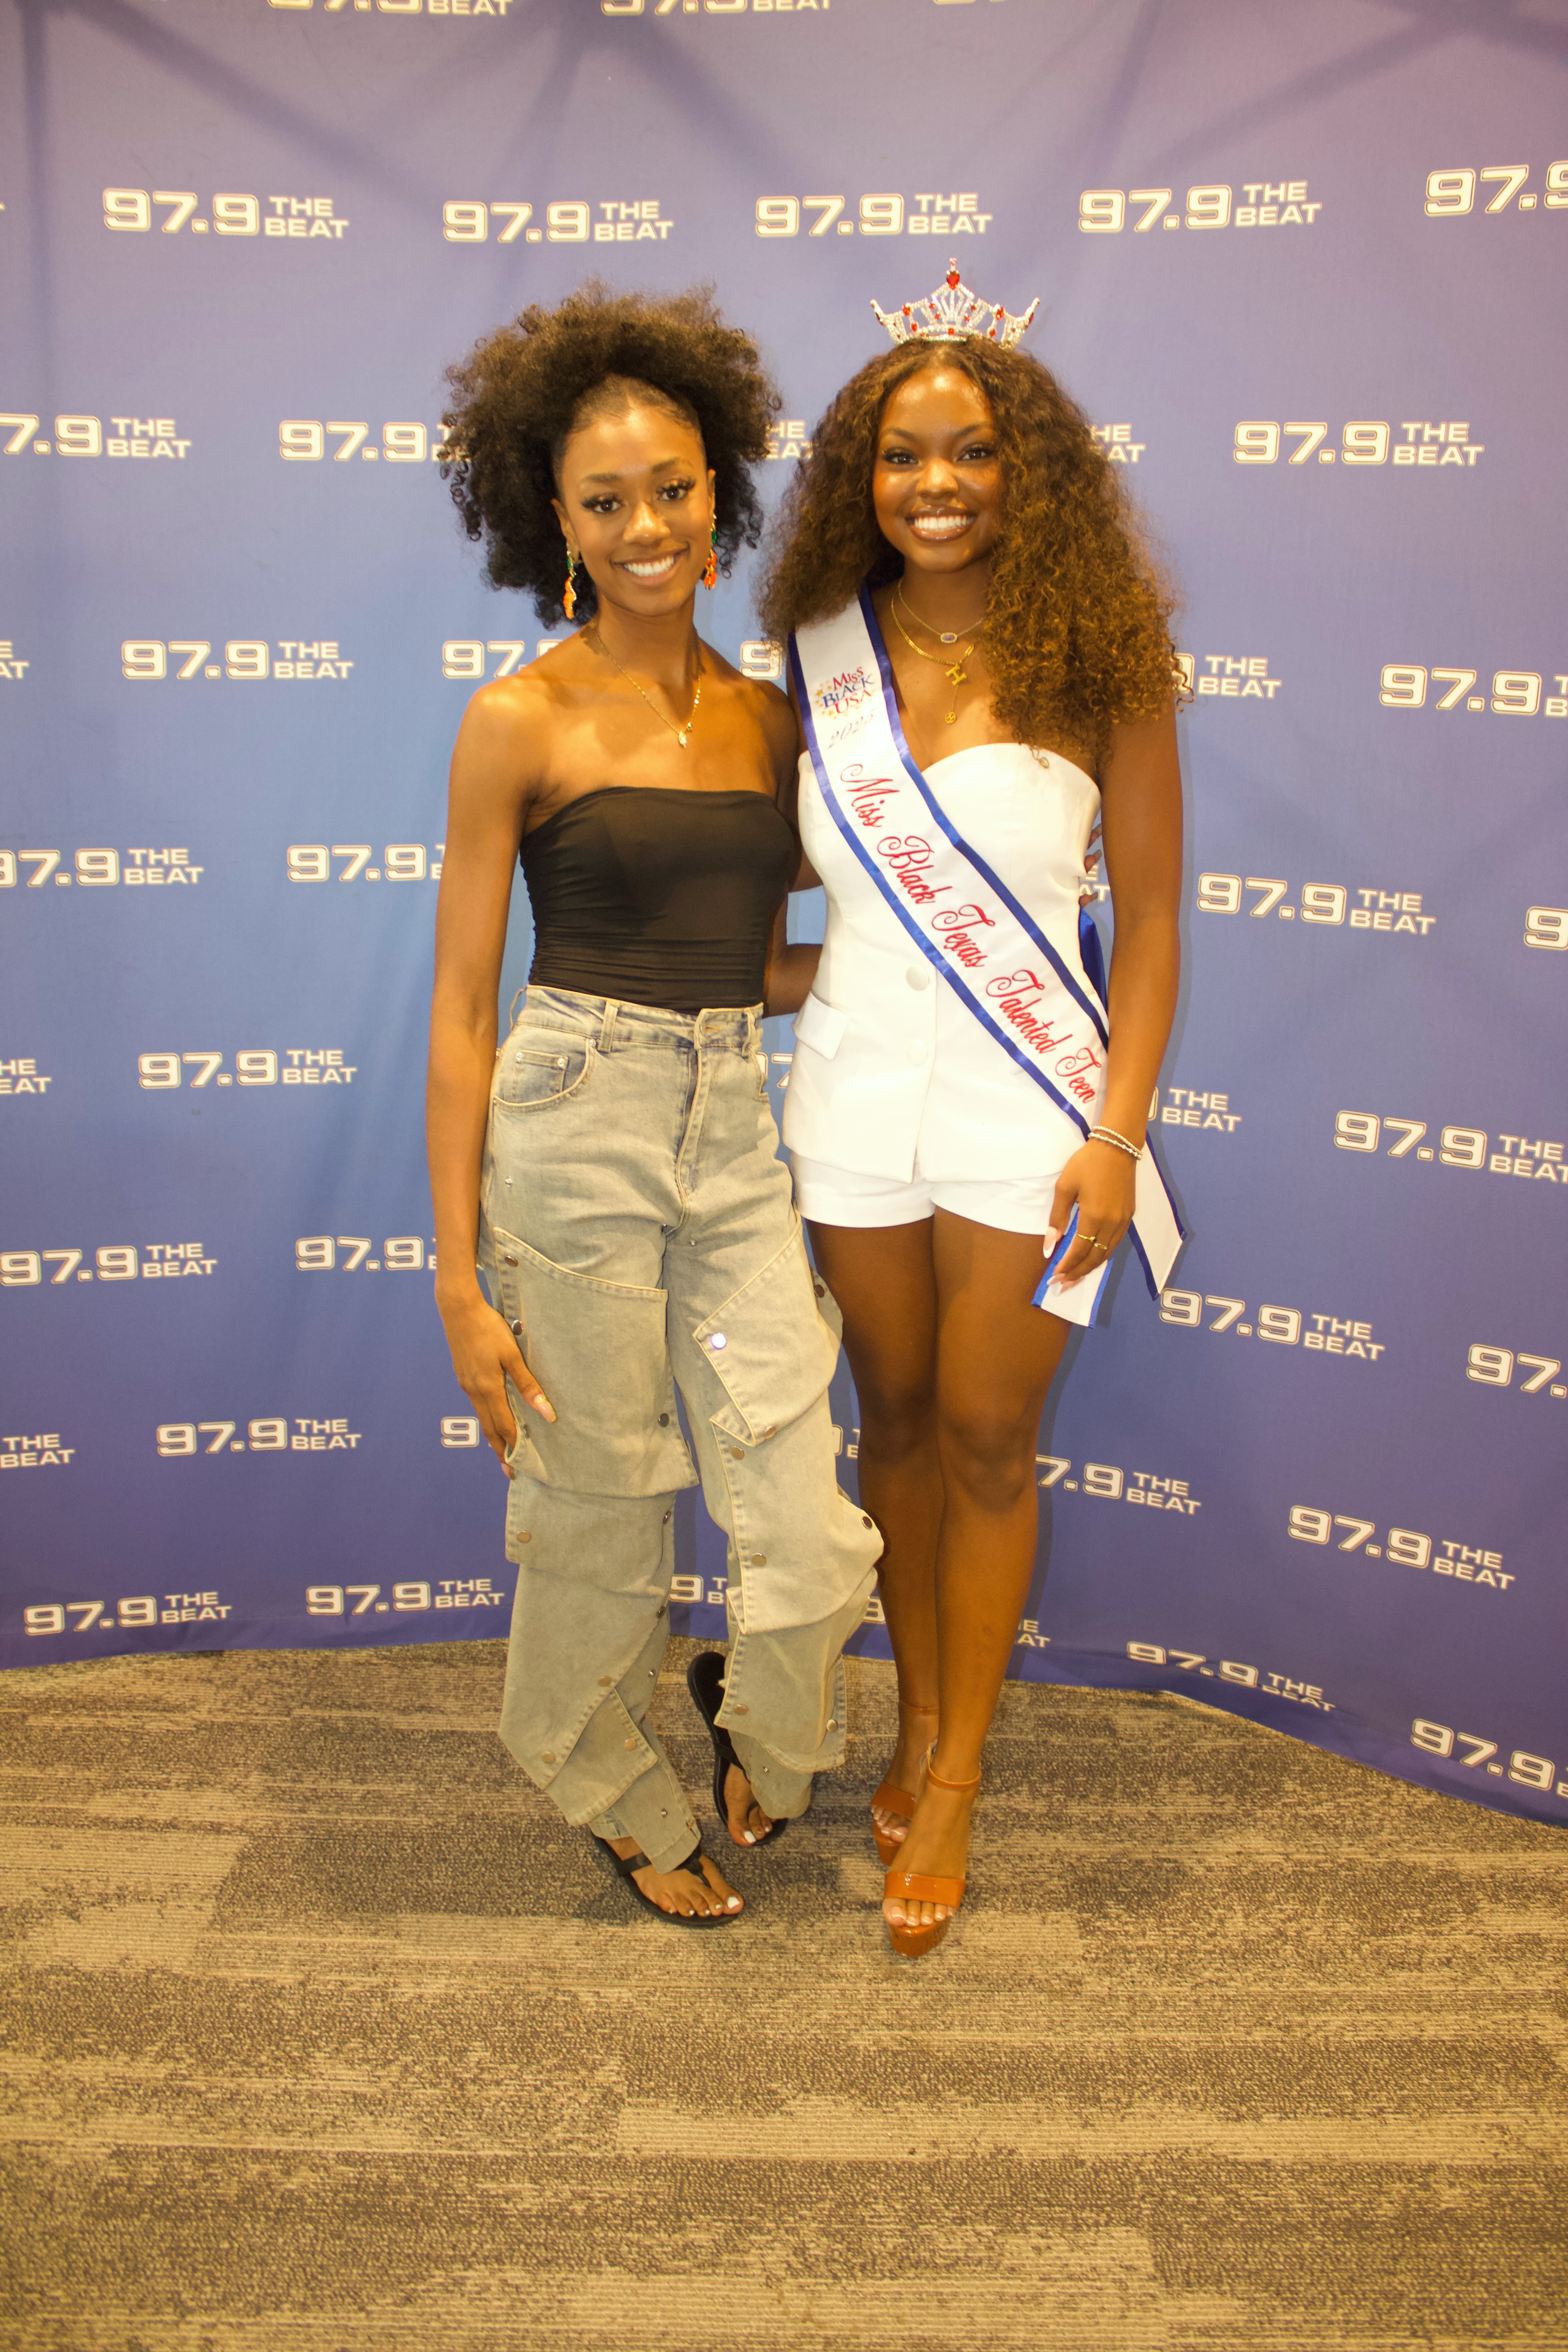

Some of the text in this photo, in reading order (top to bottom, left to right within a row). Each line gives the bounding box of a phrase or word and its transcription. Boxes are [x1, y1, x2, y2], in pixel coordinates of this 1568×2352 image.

[427, 0, 512, 15] BEAT
[915, 193, 978, 212] THE
[1243, 181, 1307, 203] THE
[103, 187, 260, 235] 97.9
[269, 196, 333, 216] THE
[600, 201, 659, 220] THE
[755, 194, 904, 236] 97.9
[1079, 184, 1232, 231] 97.9
[1235, 202, 1322, 227] BEAT
[264, 218, 349, 238] BEAT
[443, 201, 589, 242] 97.9
[594, 221, 673, 241] BEAT
[907, 214, 992, 234] BEAT
[0, 414, 102, 456] 7.9
[111, 417, 175, 437] THE
[766, 420, 806, 439] HE
[1090, 423, 1132, 442] HE
[1401, 421, 1469, 442] THE
[106, 438, 191, 458] BEAT
[279, 419, 426, 461] 97.9
[764, 441, 818, 459] EAT
[1234, 421, 1390, 463] 97.9
[1393, 445, 1484, 465] BEAT
[122, 640, 269, 679] 97.9
[279, 641, 338, 659] THE
[0, 661, 29, 679] AT
[273, 661, 354, 679] BEAT
[1205, 655, 1268, 677] THE
[1198, 676, 1282, 699] BEAT
[1380, 664, 1542, 715] 97.9
[835, 689, 871, 713] USA
[127, 848, 189, 865] THE
[287, 844, 426, 881] 97.9
[123, 866, 204, 884] BEAT
[1079, 883, 1111, 902] AT
[1198, 872, 1345, 924] 97.9
[1357, 888, 1423, 913] THE
[840, 764, 1102, 1103] Miss Black Texas Talented Teen
[1349, 909, 1436, 934] BEAT
[0, 1058, 36, 1075] HE
[139, 1050, 278, 1089] 97.9
[286, 1050, 343, 1065] THE
[0, 1077, 51, 1094] EAT
[281, 1067, 358, 1084] BEAT
[1169, 1087, 1228, 1111] THE
[1161, 1107, 1242, 1133] BEAT
[1334, 1110, 1487, 1169] 97.9
[1499, 1134, 1564, 1160] THE
[145, 1243, 203, 1259] THE
[296, 1236, 424, 1271] 97.9
[0, 1246, 138, 1286] 97.9
[142, 1259, 218, 1278] BEAT
[1159, 1287, 1301, 1345] 97.9
[1311, 1313, 1372, 1339] THE
[1303, 1332, 1385, 1361] BEAT
[1466, 1343, 1567, 1398] 97.
[157, 1418, 287, 1457] 97.9
[295, 1419, 349, 1435] THE
[3, 1435, 61, 1451] THE
[290, 1434, 361, 1451] BEAT
[0, 1449, 74, 1469] BEAT
[1036, 1454, 1124, 1499] 7.9
[1132, 1471, 1189, 1497] THE
[1126, 1488, 1201, 1515] BEAT
[1288, 1505, 1431, 1569] 97.9
[1441, 1540, 1503, 1570] THE
[1433, 1555, 1515, 1590] BEAT
[306, 1581, 431, 1615] 97.9
[439, 1579, 492, 1593] THE
[165, 1592, 219, 1607] THE
[434, 1592, 505, 1608] BEAT
[24, 1597, 158, 1635] 97.9
[161, 1605, 232, 1624] BEAT
[1017, 1633, 1051, 1648] AT
[1127, 1641, 1258, 1688] 97.9
[1268, 1672, 1323, 1700] THE
[1412, 1718, 1555, 1790] 97.9
